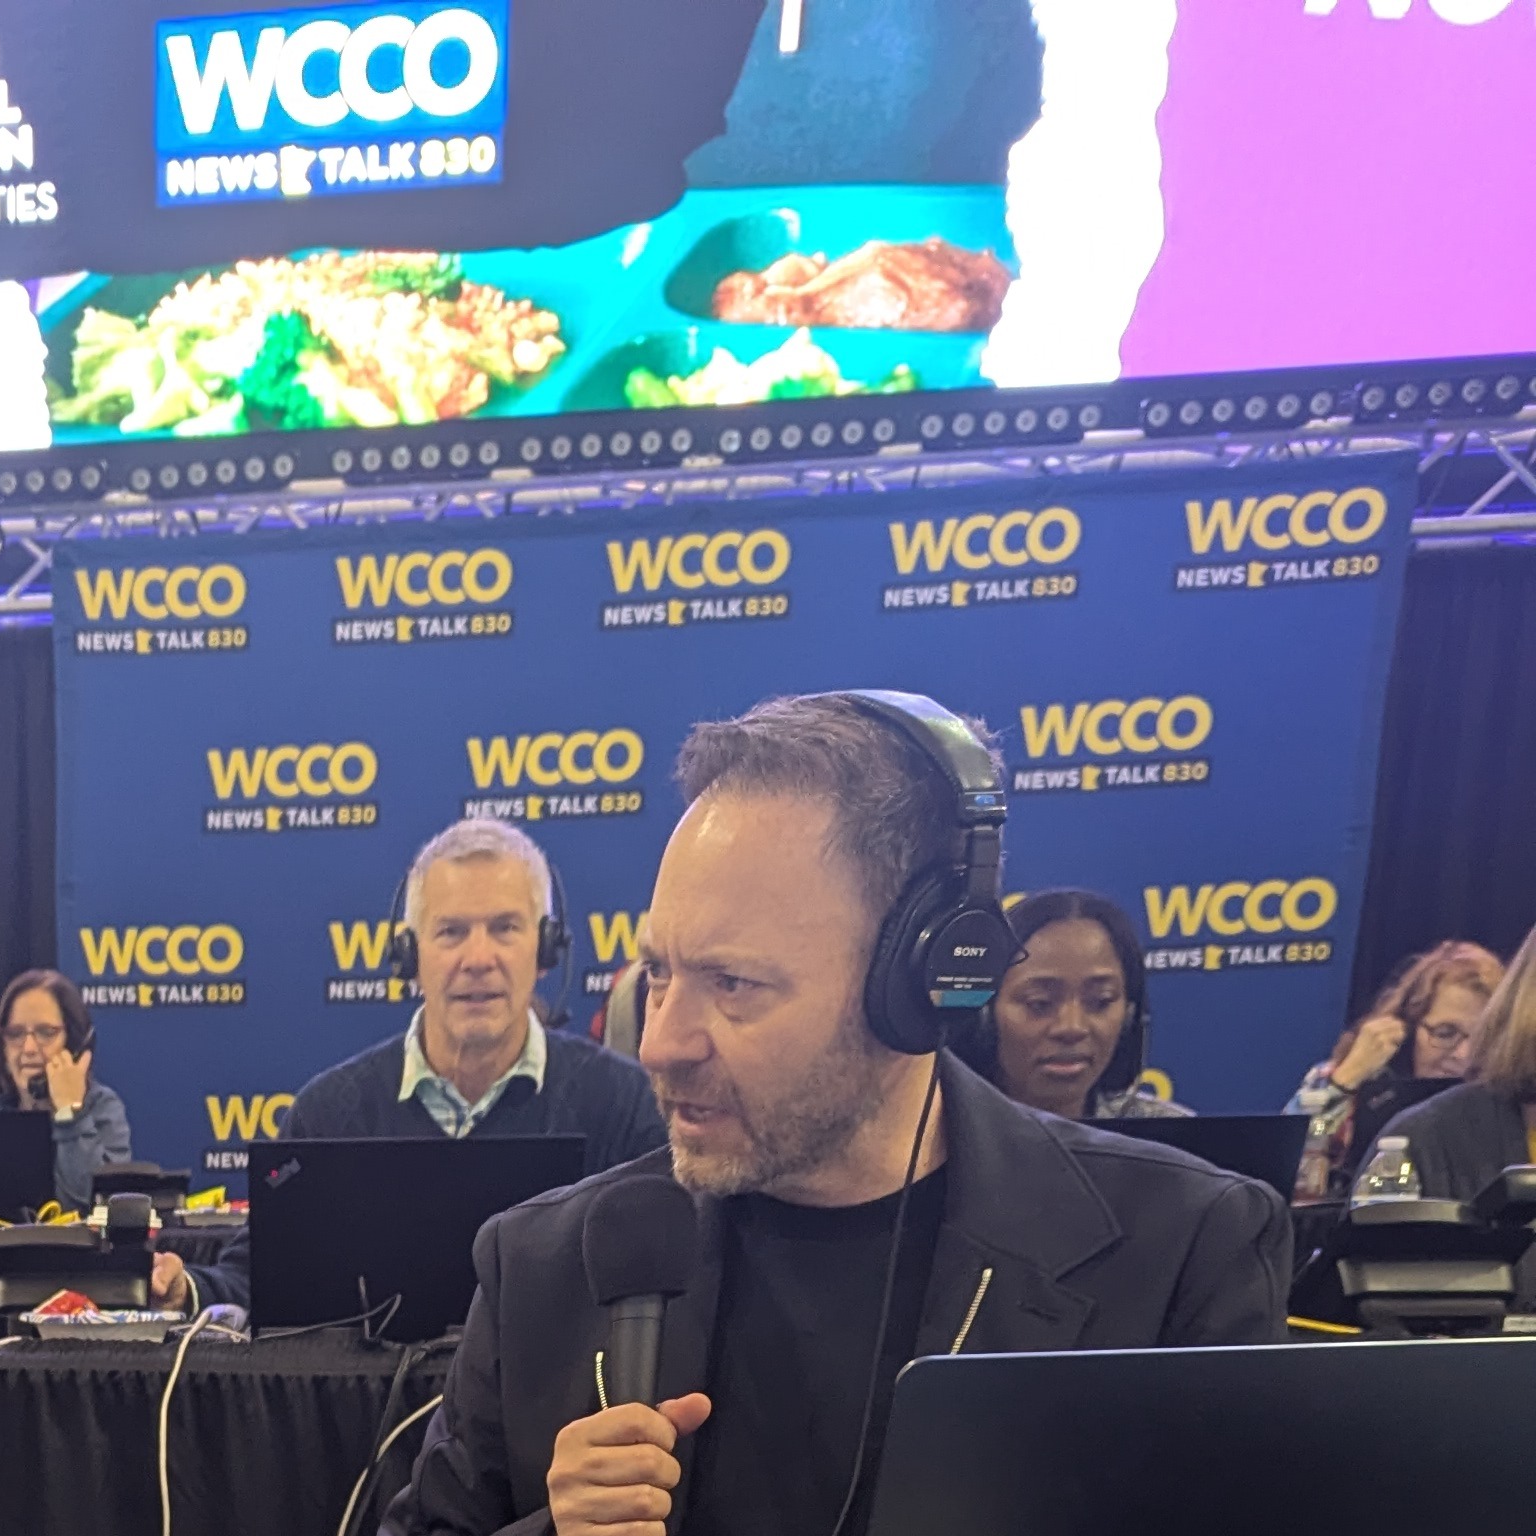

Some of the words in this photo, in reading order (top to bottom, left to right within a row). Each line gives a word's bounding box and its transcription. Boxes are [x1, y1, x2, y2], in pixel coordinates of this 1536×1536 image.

[165, 10, 498, 133] WCCO
[166, 152, 277, 196] NEWS
[317, 142, 413, 186] TALK
[420, 136, 495, 178] 830
[890, 507, 1080, 574] WCCO
[1186, 488, 1386, 553] WCCO
[337, 549, 511, 608] WCCO
[607, 530, 789, 592] WCCO
[1177, 566, 1246, 587] NEWS
[1272, 560, 1329, 580] TALK
[1333, 555, 1378, 576] 830
[76, 565, 245, 619] WCCO
[604, 603, 669, 625] NEWS
[690, 599, 742, 618] TALK
[745, 596, 787, 616] 830
[885, 585, 953, 607] NEWS
[974, 579, 1029, 600] TALK
[1032, 576, 1076, 596] 830
[78, 630, 138, 650] NEWS
[156, 631, 204, 648] TALK
[208, 628, 246, 647] 830
[336, 620, 395, 640] NEWS
[417, 617, 467, 636] TALK
[471, 614, 511, 633] 830
[1021, 696, 1211, 757] WCCO
[208, 743, 376, 798] WCCO
[468, 730, 643, 788] WCCO
[1015, 769, 1083, 789] NEWS
[1105, 765, 1160, 784] TALK
[1163, 762, 1208, 781] 830
[208, 810, 265, 828] NEWS
[287, 808, 334, 825] TALK
[338, 806, 376, 824] 830
[466, 798, 525, 820] NEWS
[548, 796, 597, 814] TALK
[601, 793, 641, 812] 830
[1145, 879, 1336, 937] WCCO
[81, 925, 243, 975] WCCO
[954, 947, 988, 957] SONY
[1228, 945, 1283, 964] TALK
[1286, 943, 1330, 961] 830
[82, 986, 137, 1003] NEWS
[158, 986, 203, 1002] TALK
[207, 985, 243, 1002] 830
[329, 980, 390, 999] NEWS
[206, 1093, 296, 1141] WC
[207, 1152, 249, 1169] NEW
